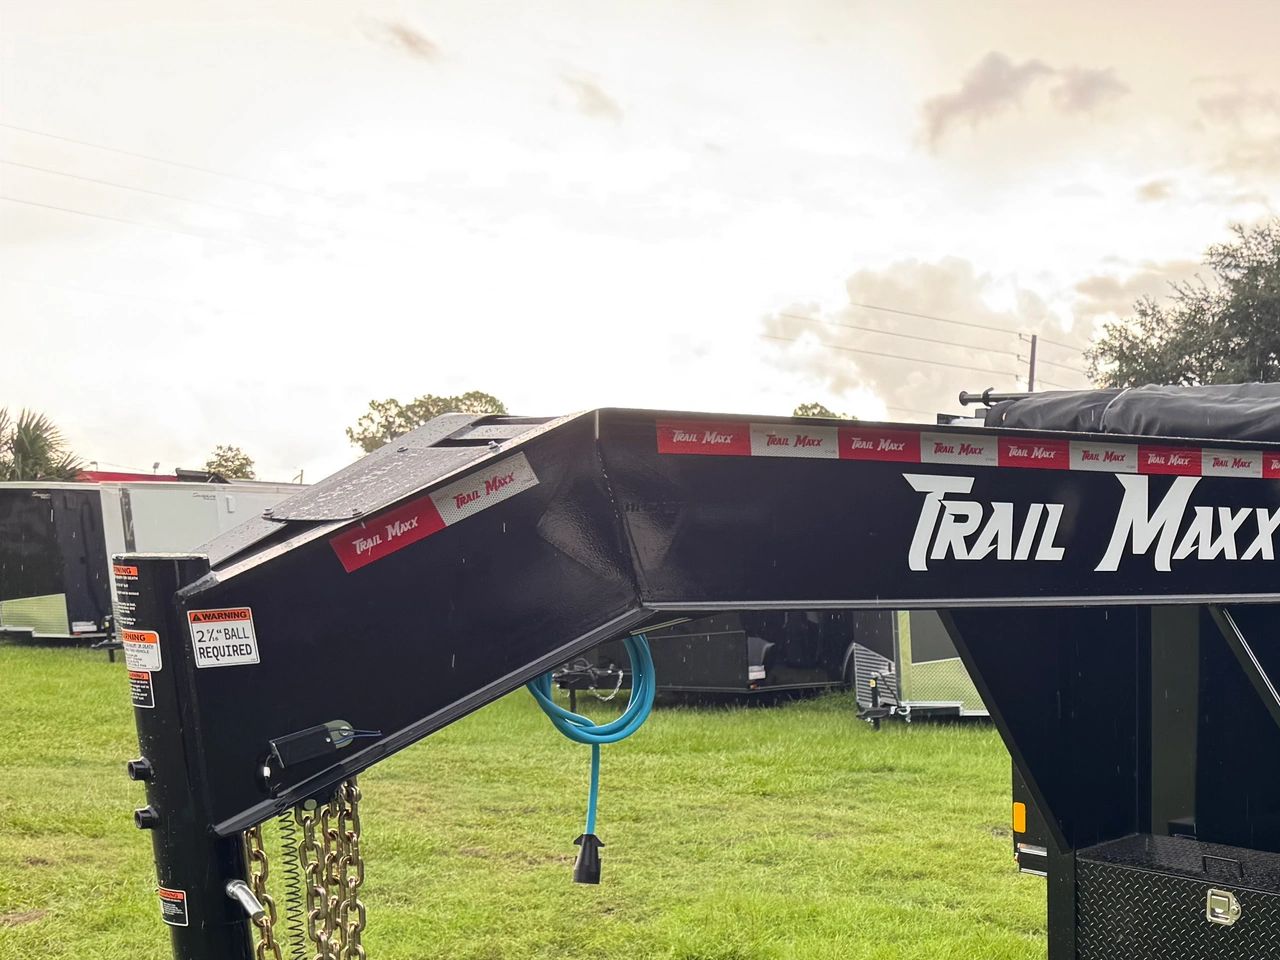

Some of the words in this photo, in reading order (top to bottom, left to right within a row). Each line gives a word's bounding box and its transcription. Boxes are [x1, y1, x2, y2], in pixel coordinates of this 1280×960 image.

[672, 430, 698, 443] TRAIL
[702, 430, 734, 444] MAXX
[766, 434, 790, 446] TRAIL
[794, 435, 822, 448] MAXX
[851, 437, 874, 450] TRAIL
[877, 438, 904, 451] MAXX
[934, 442, 955, 455] TRAIL
[958, 443, 984, 456] MAXX
[1008, 446, 1028, 458] TRAIL
[1030, 446, 1056, 460] MAXX
[1081, 450, 1101, 462] TRAIL
[1103, 450, 1126, 463] MAXX
[453, 489, 481, 509] TRAIL
[484, 472, 514, 495] MAXX
[902, 473, 1066, 572] TRAIL
[352, 533, 382, 555] TRAIL
[385, 516, 419, 541] MAXX
[202, 611, 247, 620] WARNING
[223, 627, 250, 640] BALL
[198, 643, 253, 661] REQUIRED
